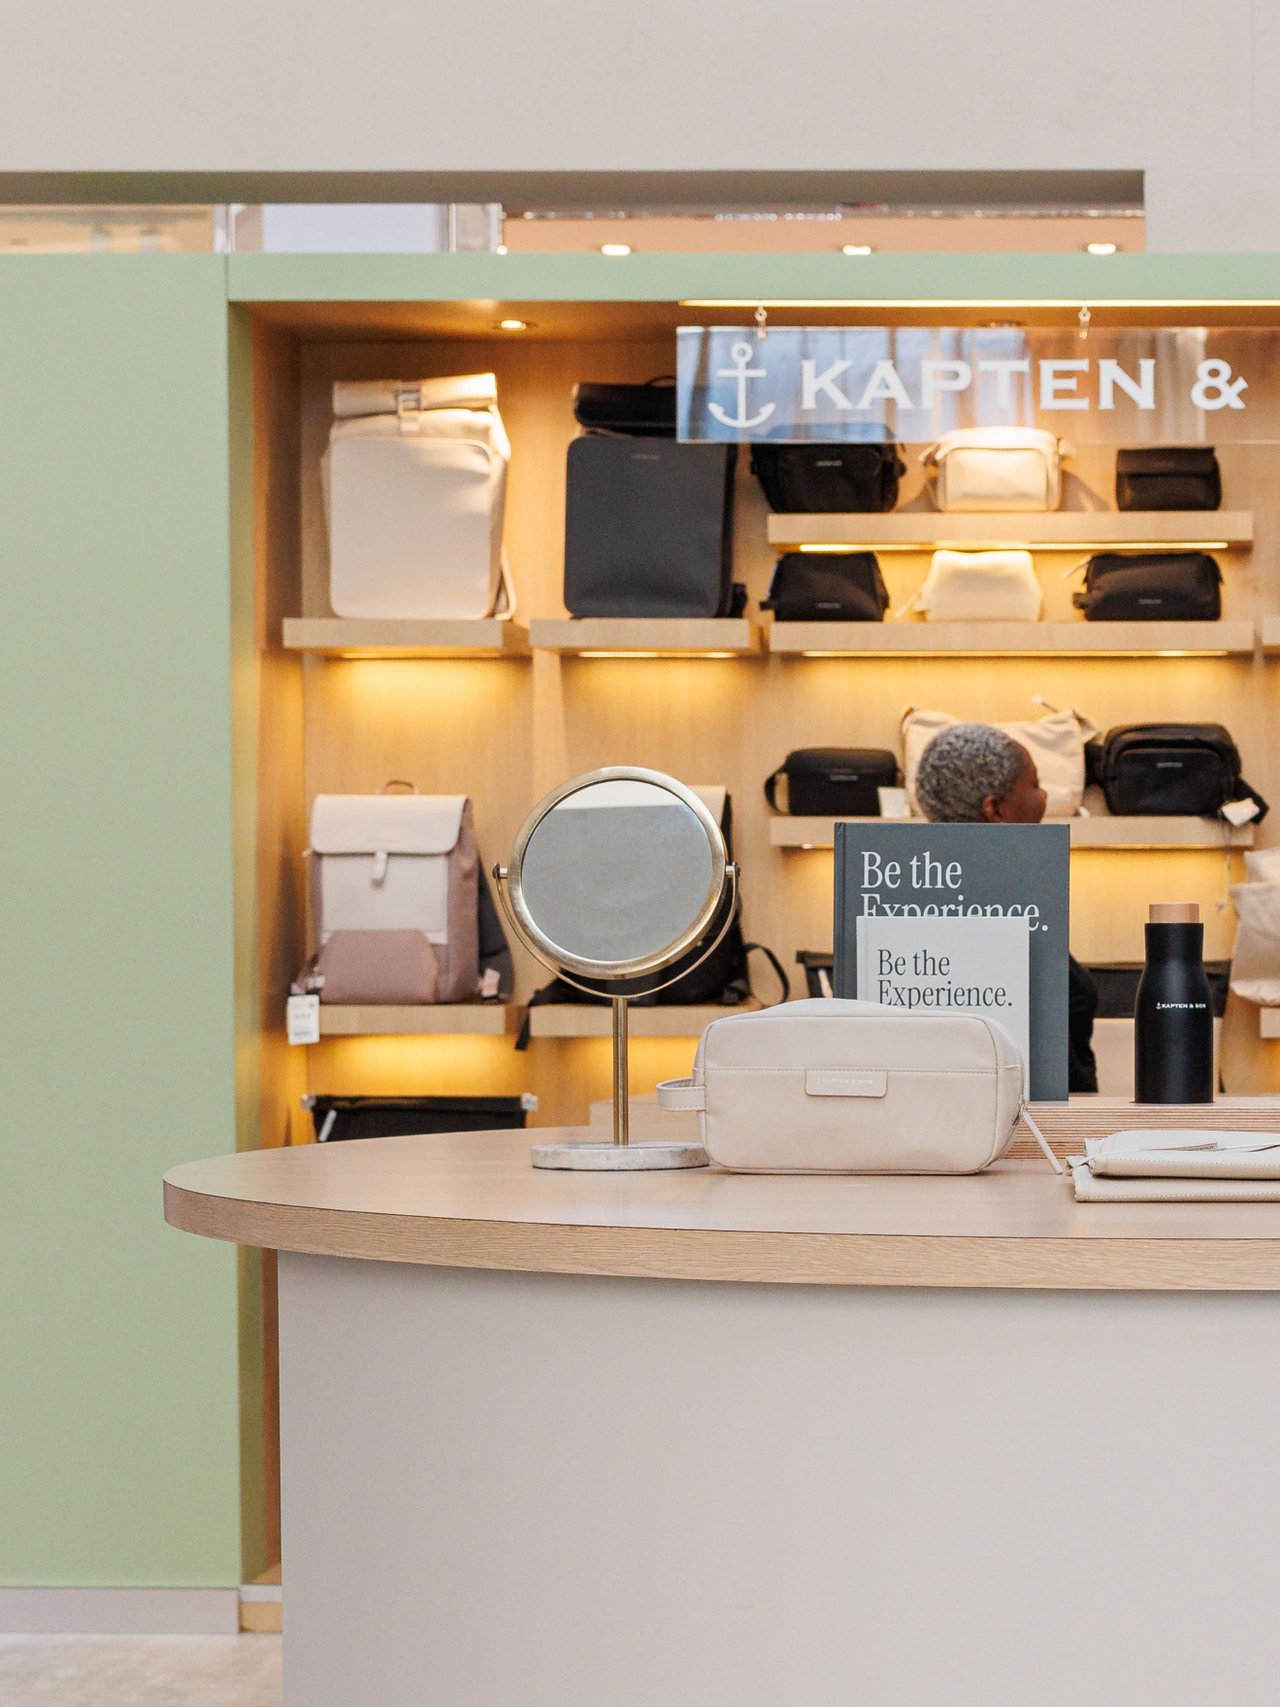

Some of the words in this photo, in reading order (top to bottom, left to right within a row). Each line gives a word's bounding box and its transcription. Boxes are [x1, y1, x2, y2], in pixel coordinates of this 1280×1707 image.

[801, 358, 1156, 410] KAPTEN
[1190, 358, 1249, 410] &
[860, 851, 901, 889] Be
[909, 851, 963, 889] the
[877, 949, 907, 976] Be
[912, 949, 951, 976] the
[877, 979, 1013, 1010] Experience.
